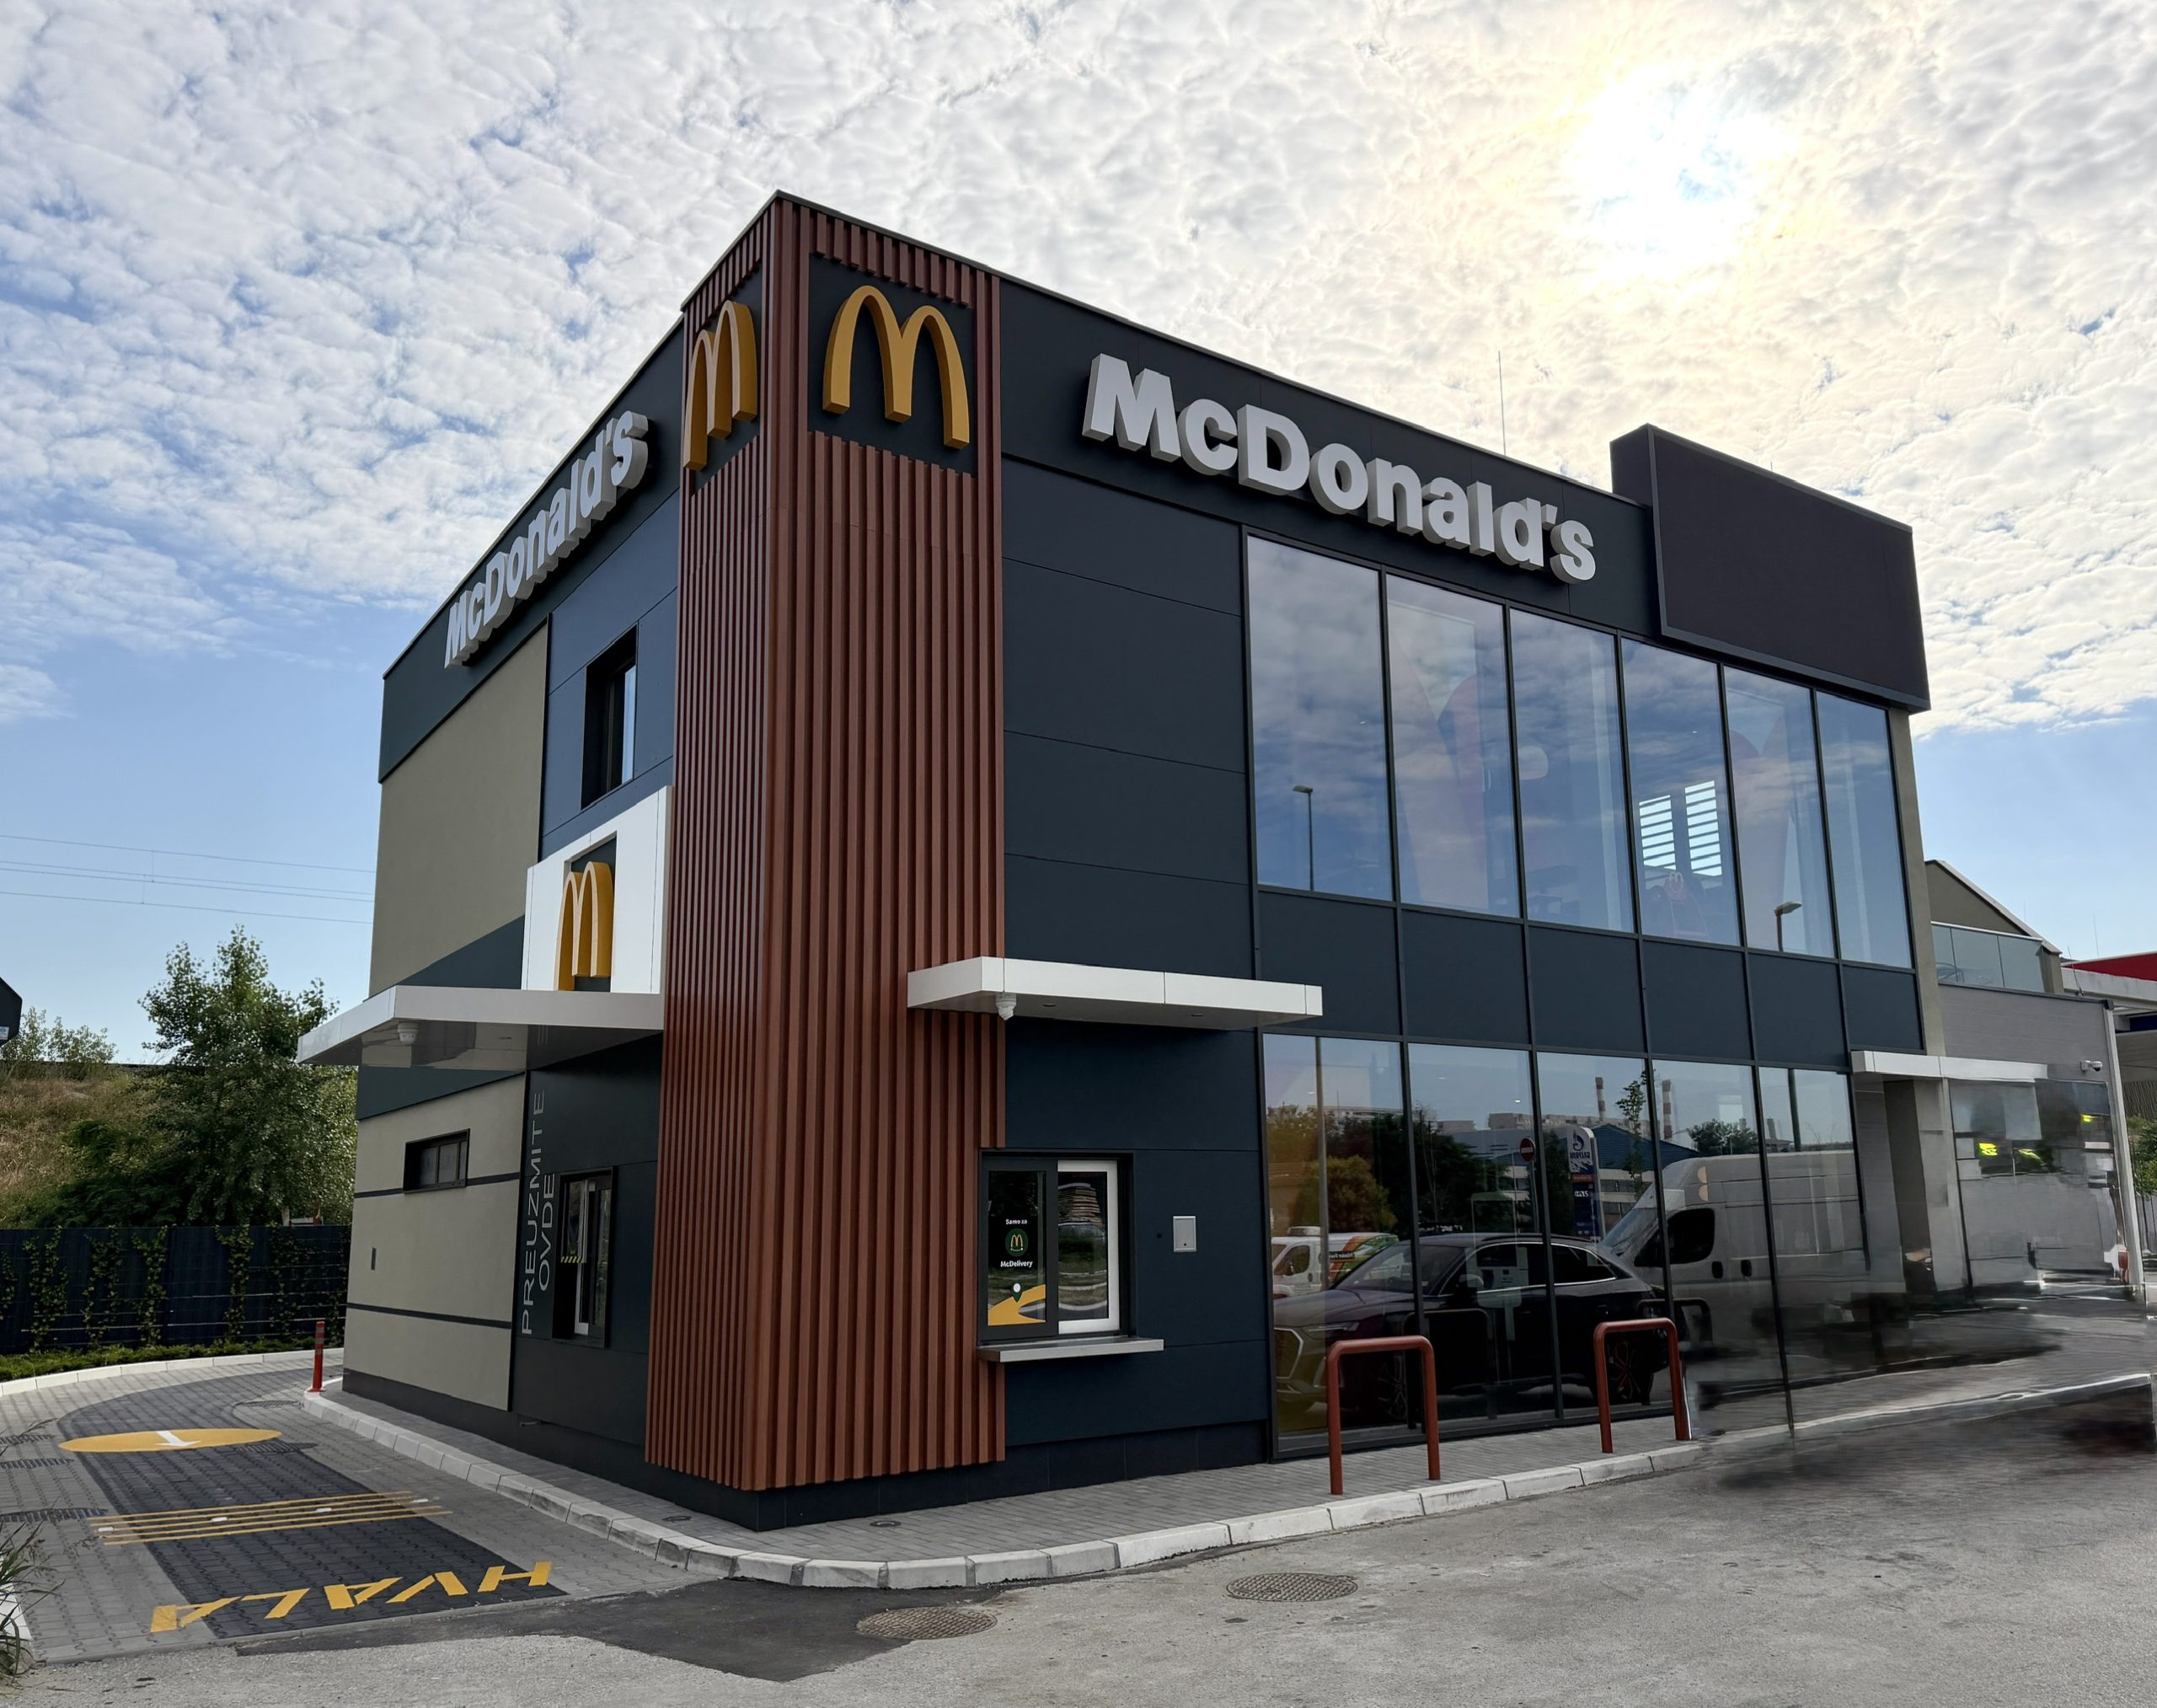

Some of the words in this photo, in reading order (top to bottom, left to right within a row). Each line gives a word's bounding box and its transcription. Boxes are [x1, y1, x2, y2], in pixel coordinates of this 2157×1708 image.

[444, 410, 649, 669] McDonald's
[1082, 352, 1597, 584] McDonald's
[521, 1089, 547, 1335] PREUZMITE
[538, 1172, 556, 1292] OVDE
[1000, 1260, 1033, 1268] McDelivery
[150, 1561, 553, 1633] HVALA
